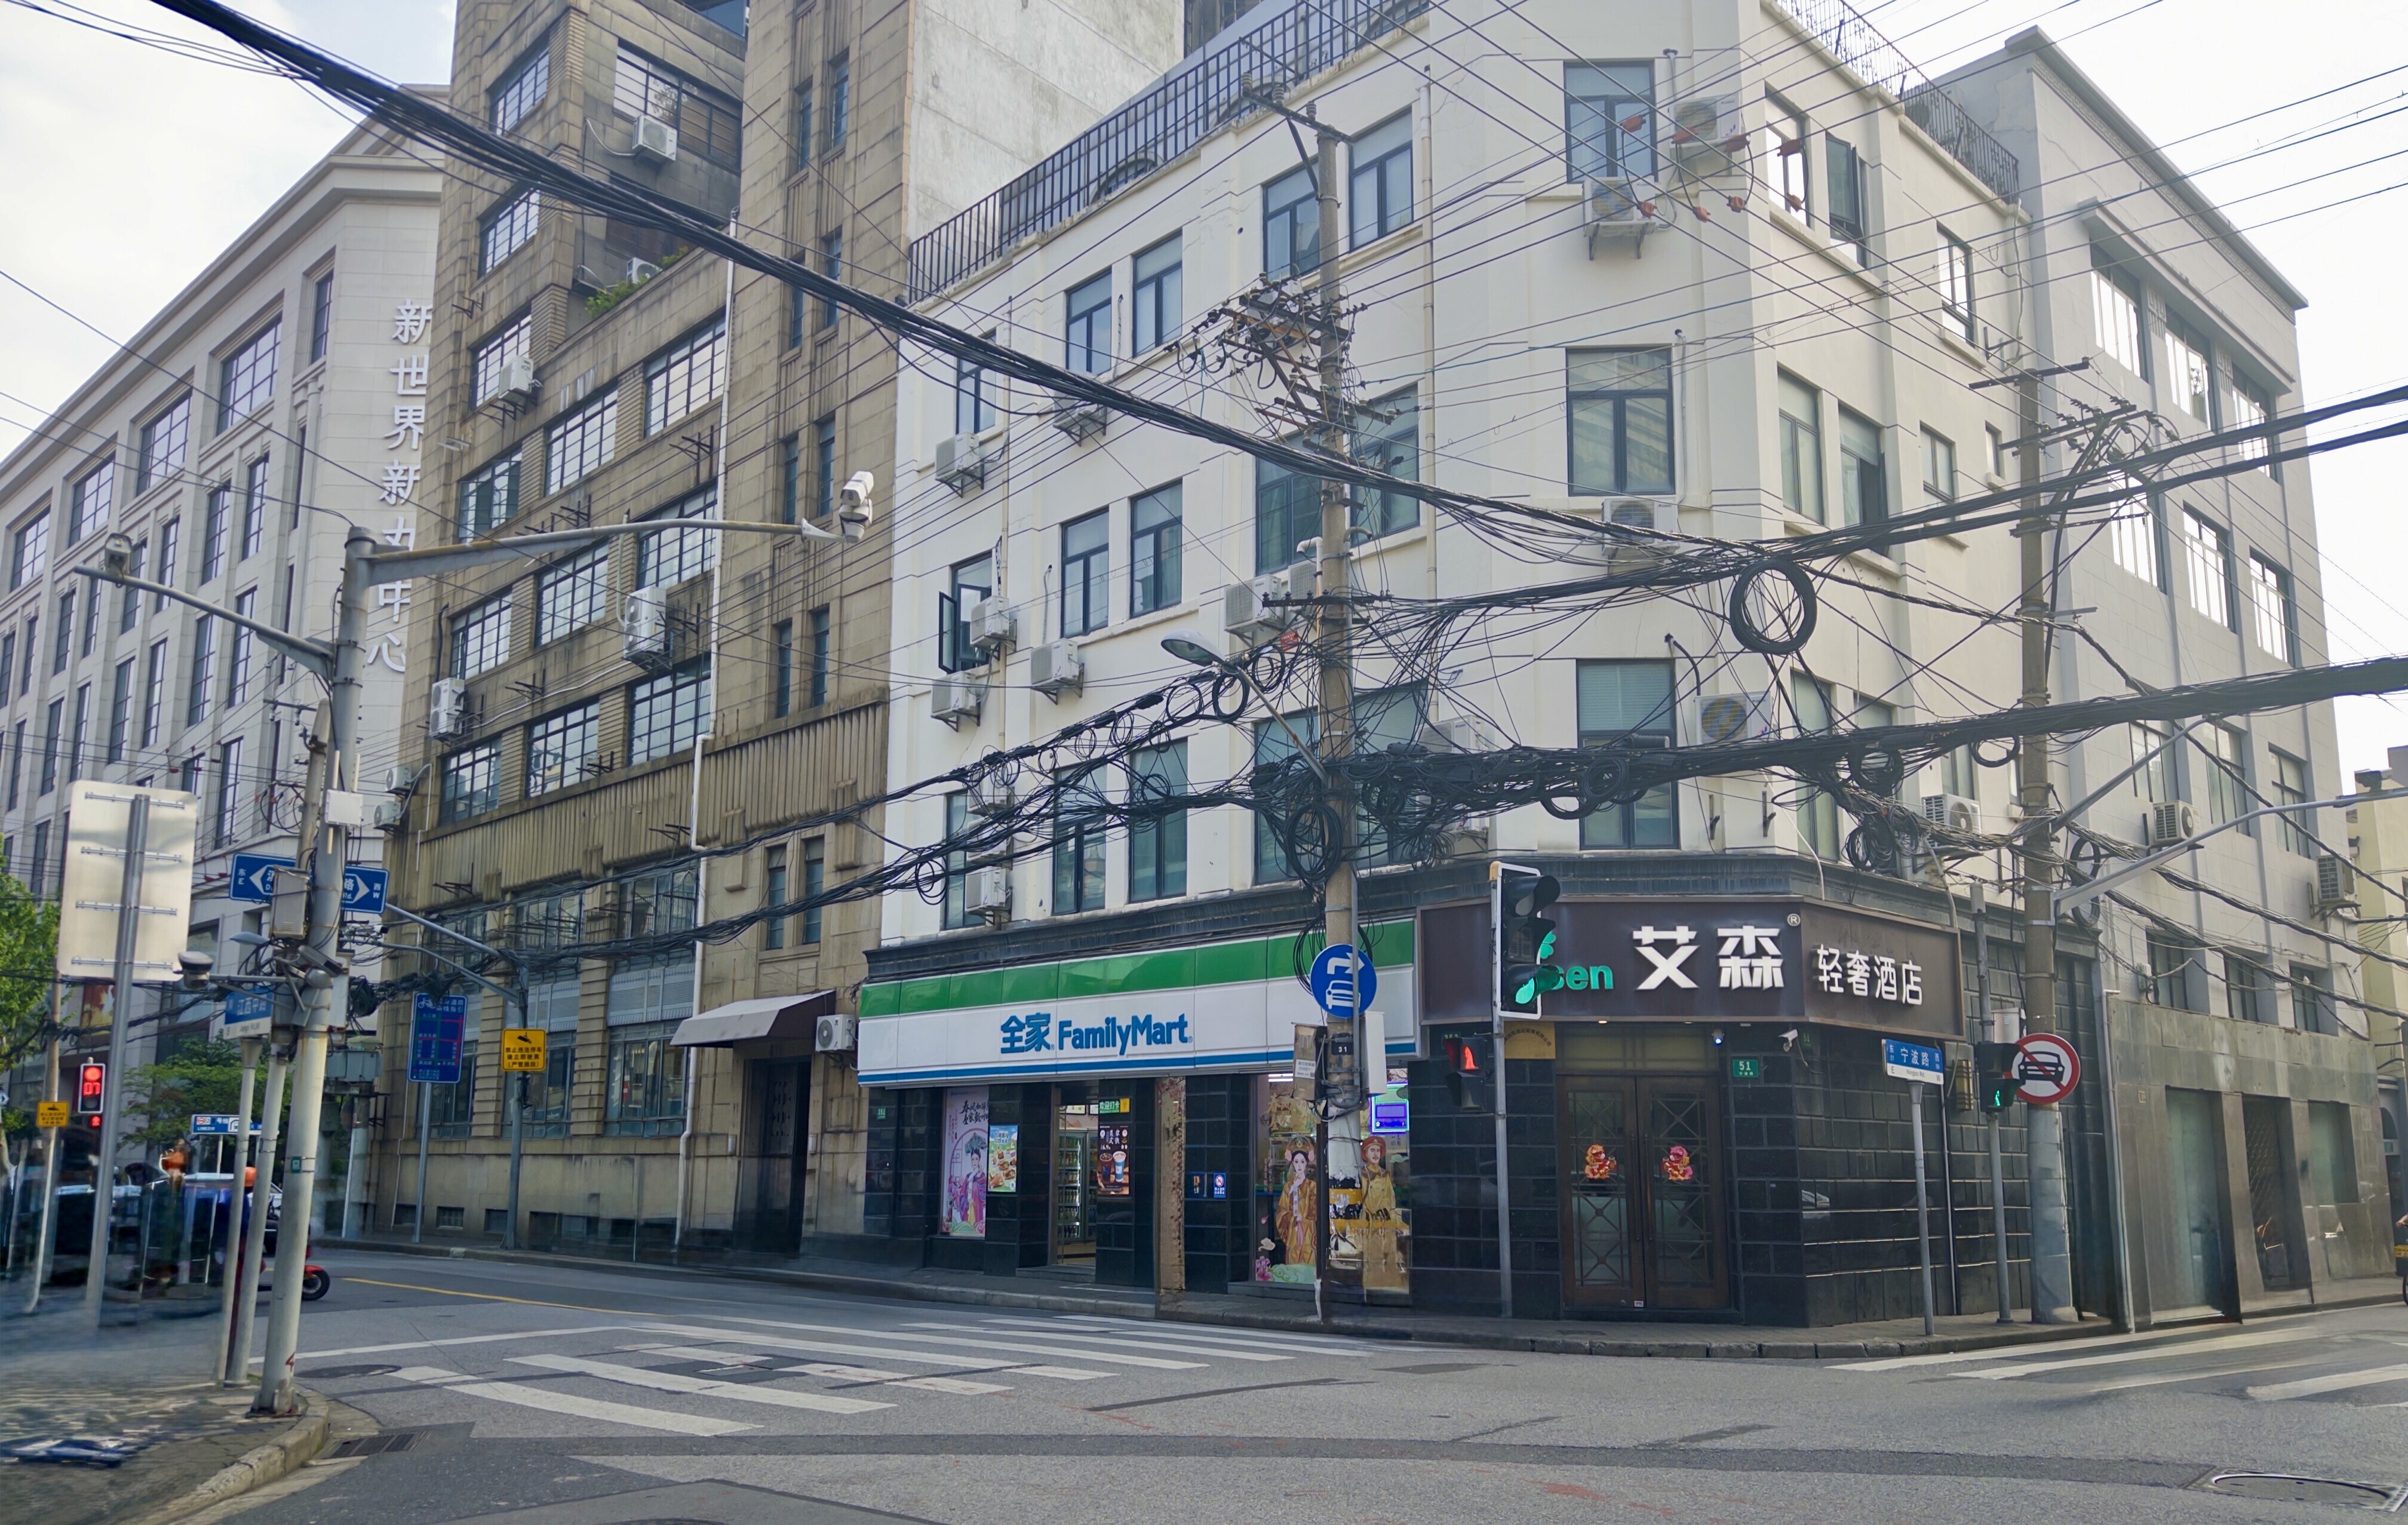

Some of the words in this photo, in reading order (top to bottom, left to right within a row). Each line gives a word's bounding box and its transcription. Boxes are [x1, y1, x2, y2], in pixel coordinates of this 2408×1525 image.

[1632, 925, 1784, 990] 艾森
[1817, 944, 1922, 1005] 轻奢酒店
[1000, 1013, 1051, 1054] 全家
[1058, 1014, 1188, 1055] FamilyMart
[1739, 1061, 1751, 1071] 51
[1891, 1066, 1895, 1074] E
[1900, 1047, 1929, 1067] 宁波路
